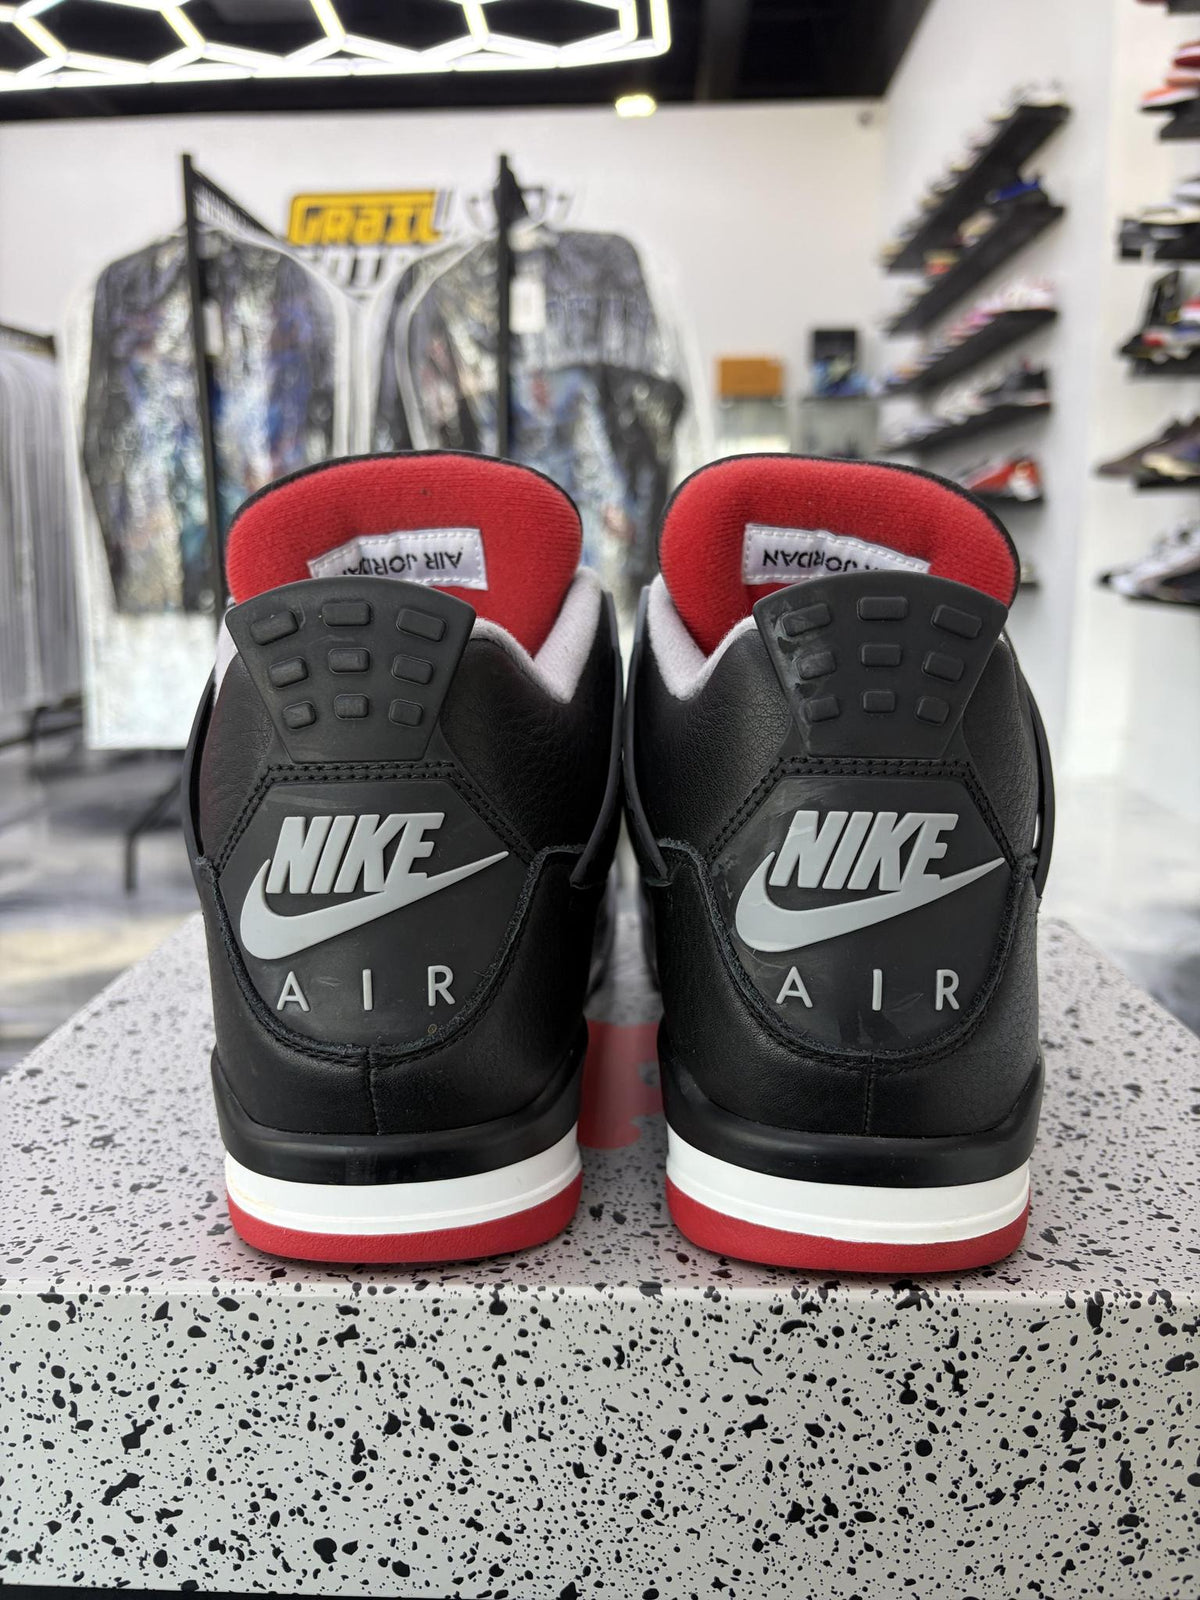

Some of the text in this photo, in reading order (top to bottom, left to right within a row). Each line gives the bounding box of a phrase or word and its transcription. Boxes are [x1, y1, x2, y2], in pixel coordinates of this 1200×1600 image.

[342, 551, 464, 576] AIR JORDA
[762, 549, 858, 573] JORDAN
[265, 812, 446, 894] NIKE
[768, 810, 960, 892] NIKE
[276, 965, 457, 1013] AIR
[775, 966, 961, 1012] AIR
